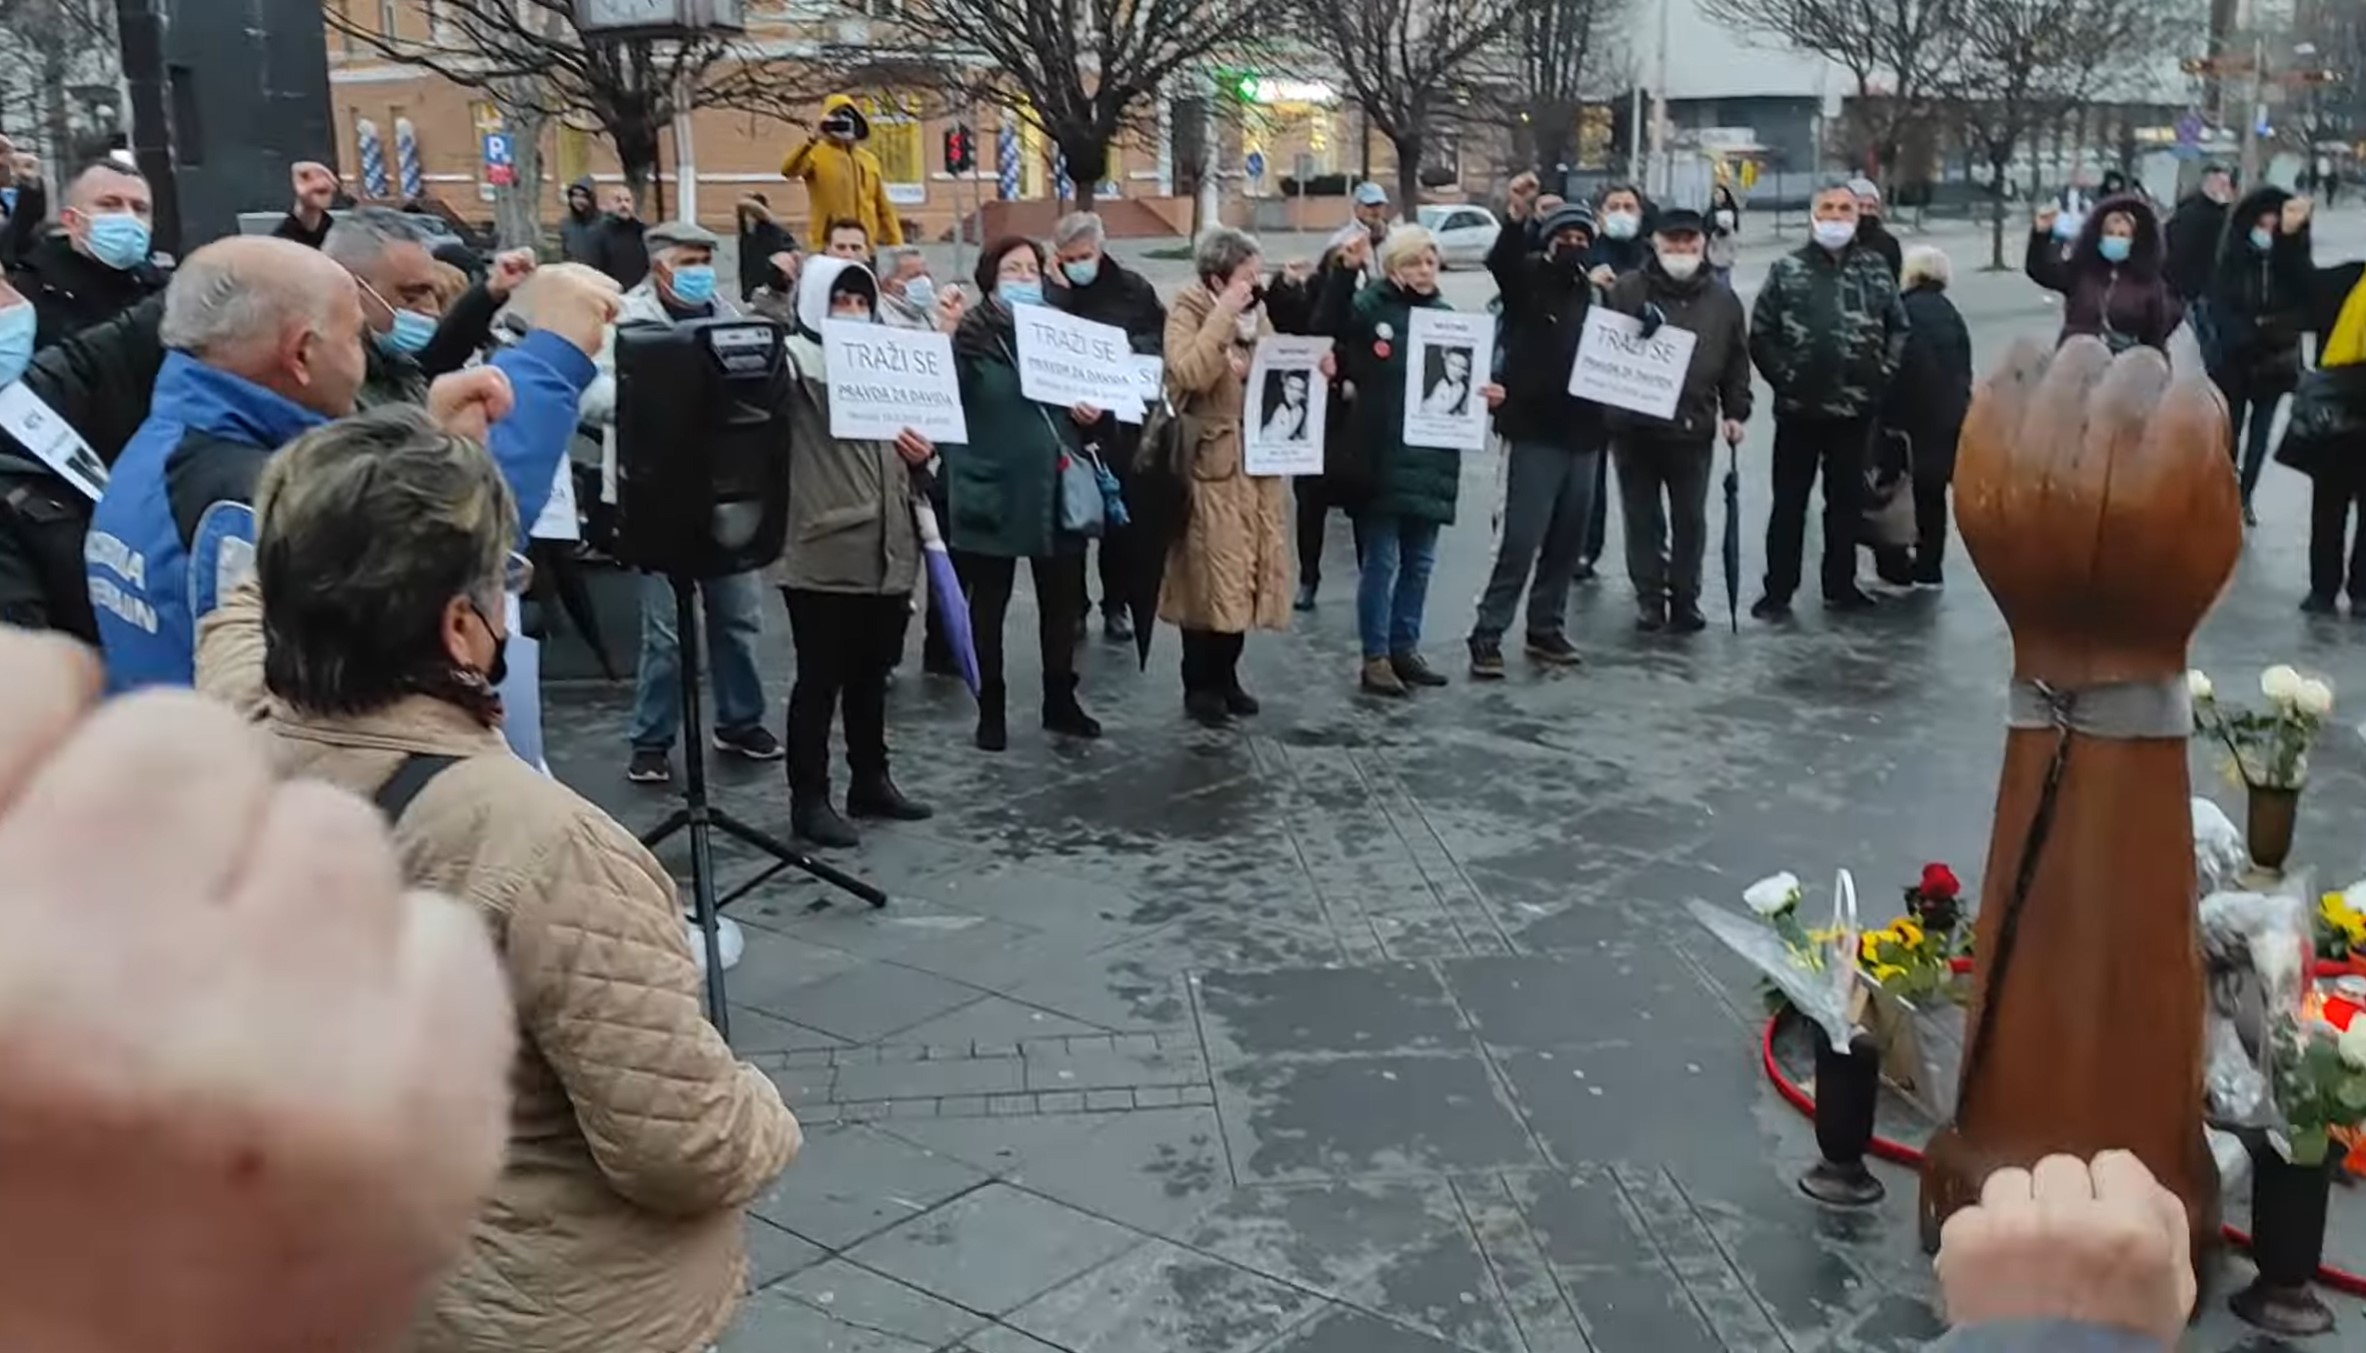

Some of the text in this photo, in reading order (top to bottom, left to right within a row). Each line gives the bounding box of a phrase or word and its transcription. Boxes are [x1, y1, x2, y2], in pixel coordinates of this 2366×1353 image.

[488, 135, 505, 160] P
[1029, 321, 1117, 364] TRAŽI SE
[1650, 340, 1677, 364] SE
[841, 340, 940, 376] TRAŽI SE
